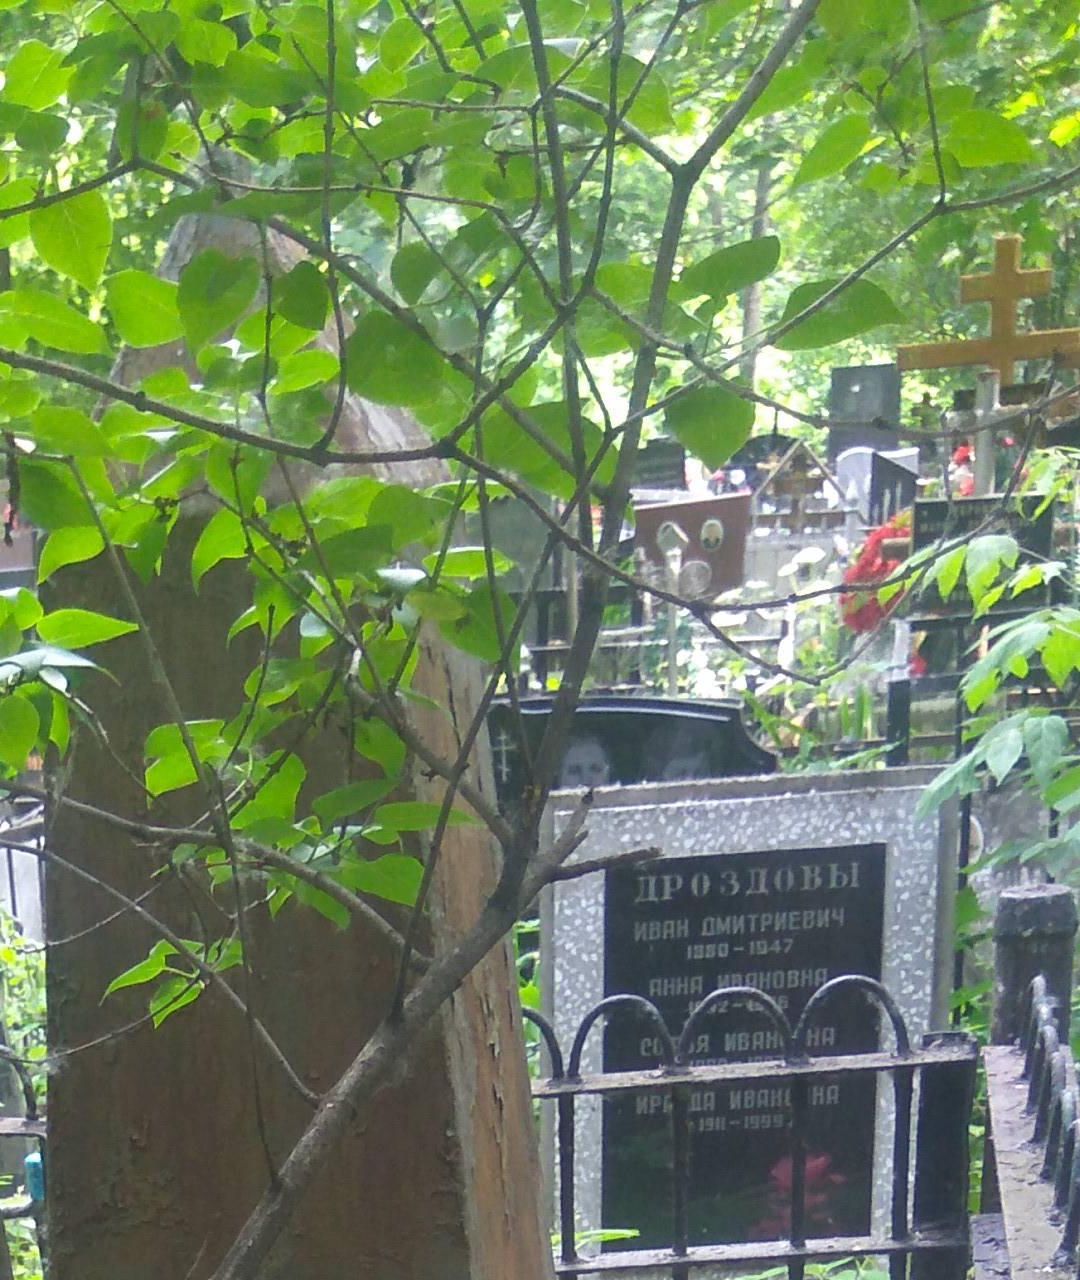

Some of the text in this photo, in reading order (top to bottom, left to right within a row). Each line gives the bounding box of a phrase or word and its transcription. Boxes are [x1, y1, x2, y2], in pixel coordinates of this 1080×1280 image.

[633, 862, 861, 903] ДРОЗДОВЫ
[634, 907, 845, 942] ИВАН ДМИТРИЕВИЧ
[649, 968, 829, 996] АННА ИВАНОВНА
[724, 1027, 835, 1053] ИВАННА
[635, 1084, 840, 1115] ИРАДА ИВАННА
